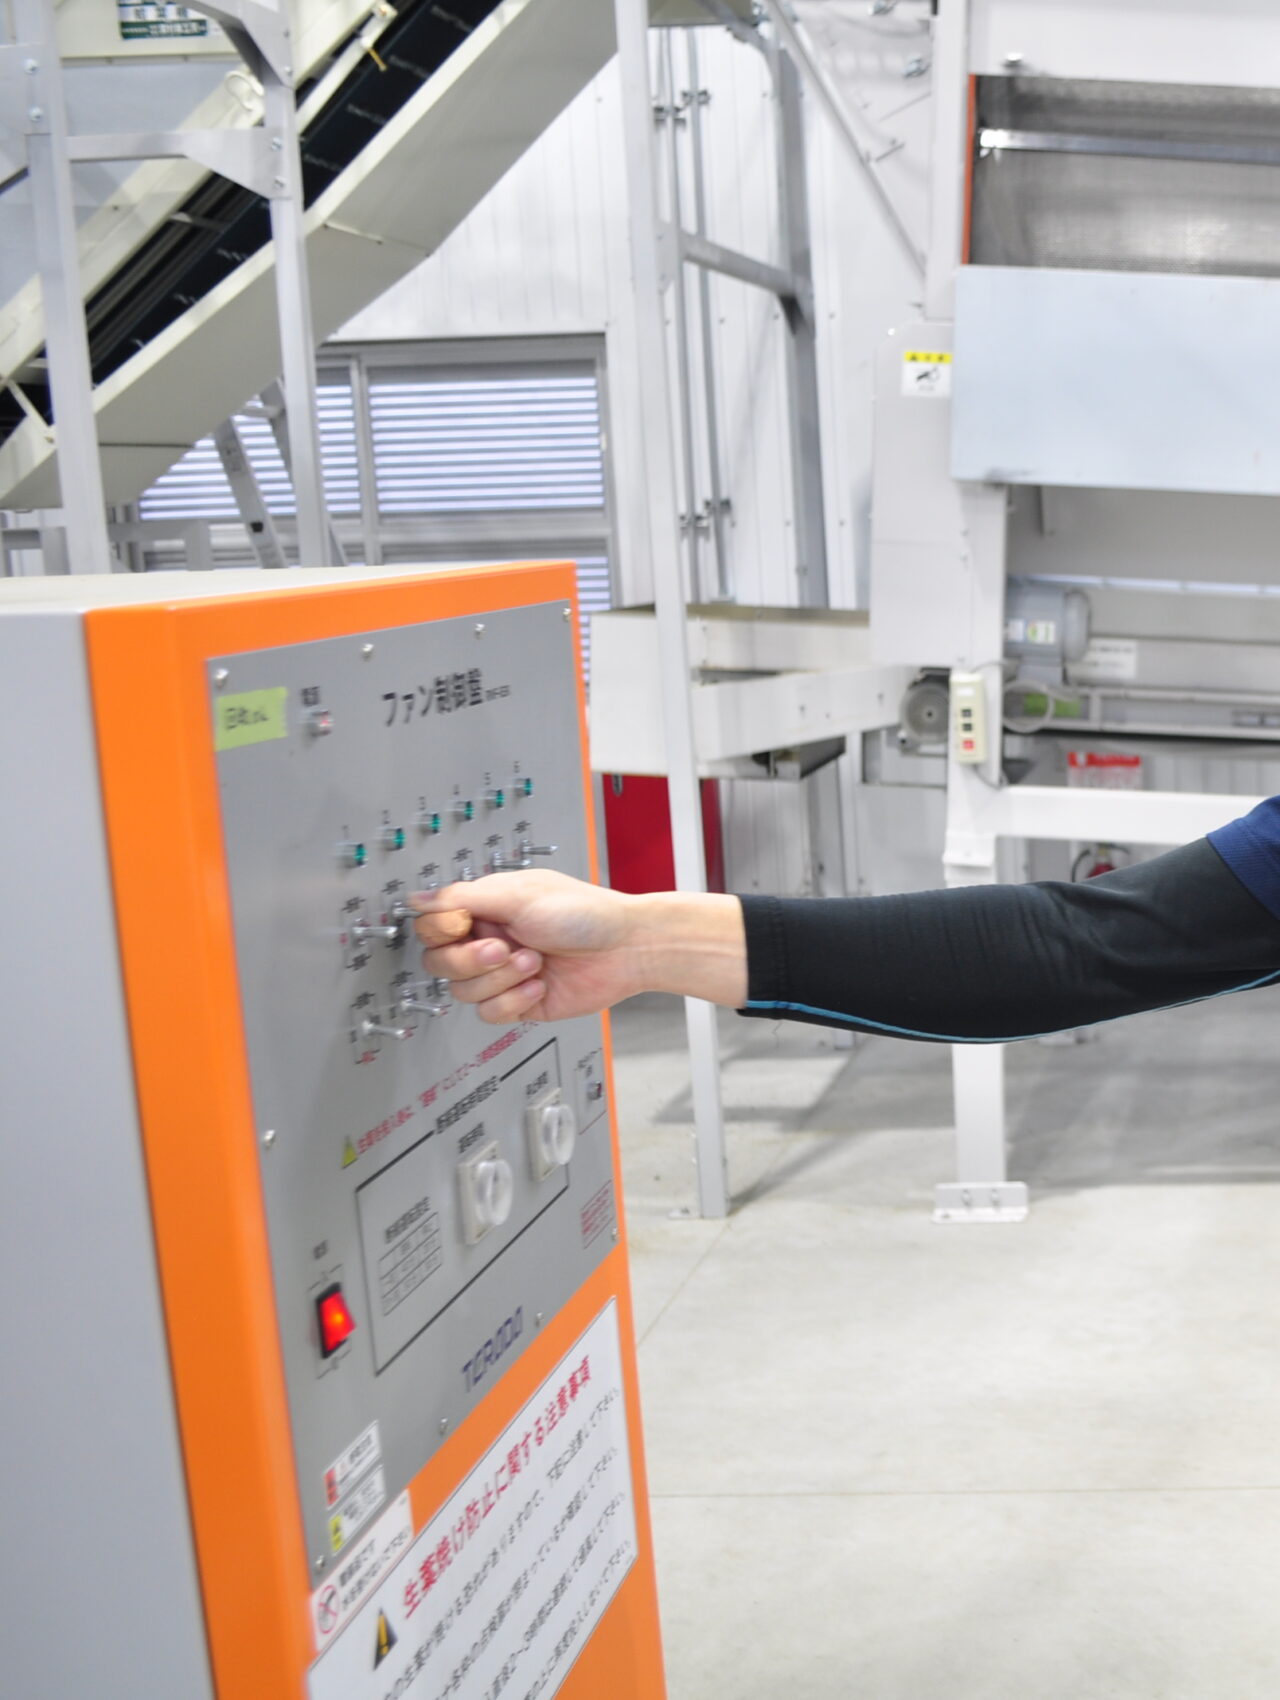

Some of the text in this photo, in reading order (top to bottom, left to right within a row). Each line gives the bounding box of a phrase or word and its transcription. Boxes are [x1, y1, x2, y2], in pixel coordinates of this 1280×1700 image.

[382, 667, 483, 727] ファン制御盤
